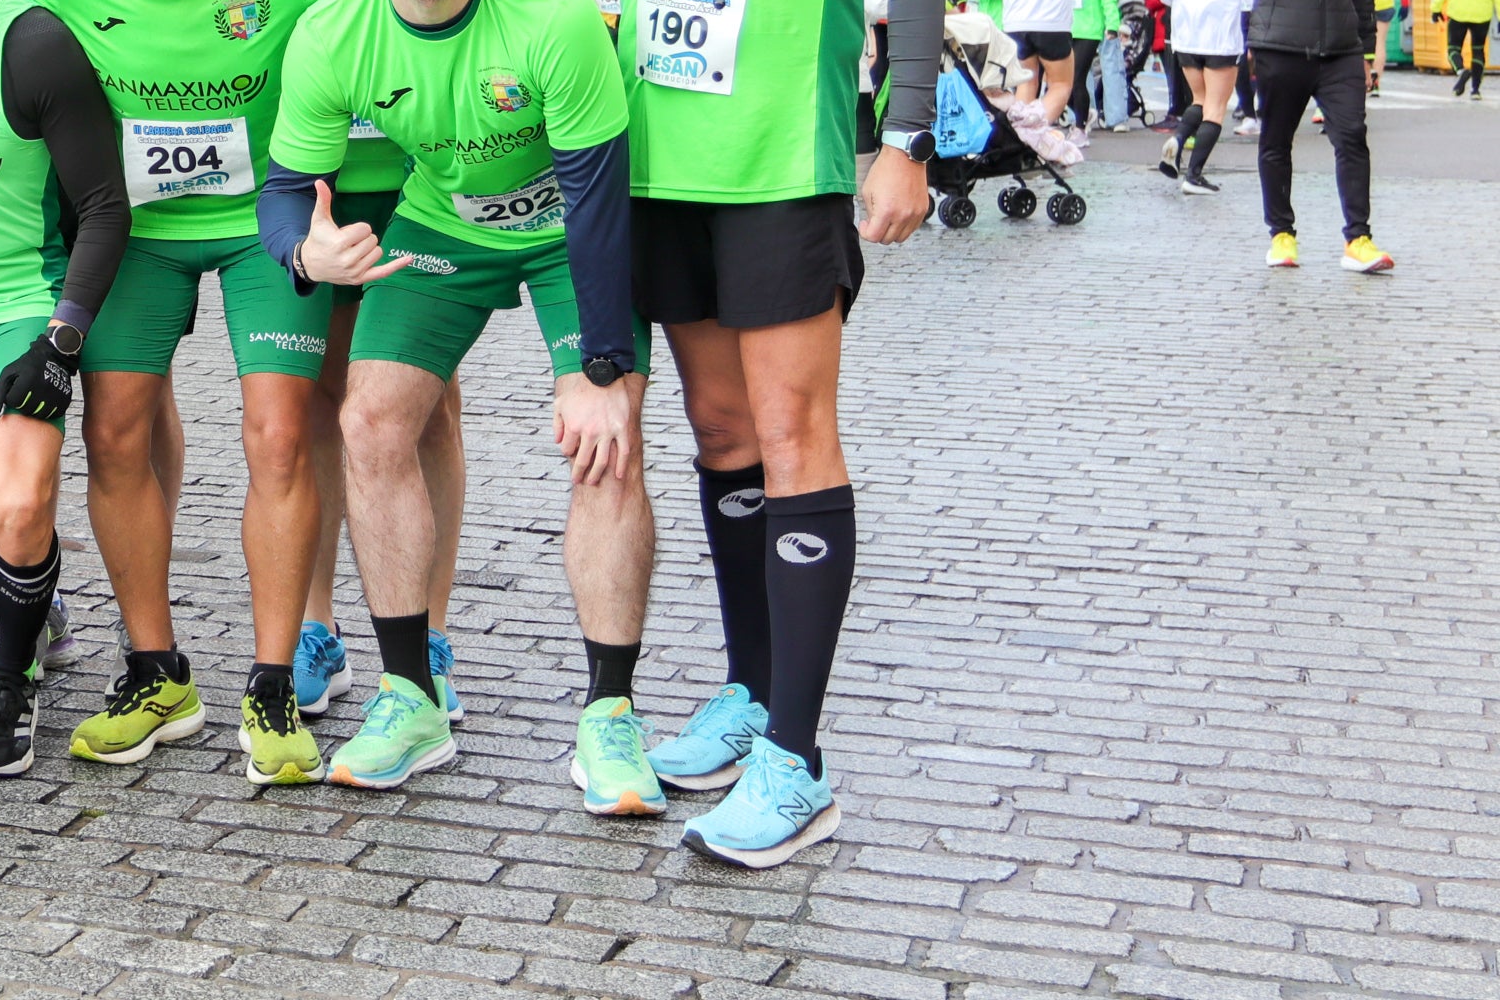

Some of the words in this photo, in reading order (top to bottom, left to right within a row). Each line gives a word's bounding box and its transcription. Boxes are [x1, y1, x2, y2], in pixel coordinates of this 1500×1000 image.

[649, 8, 708, 50] 190
[647, 52, 698, 79] HESAN
[140, 94, 243, 111] TELECOM
[133, 124, 141, 135] III
[143, 125, 184, 136] CARRERA
[185, 123, 234, 136] SOLIDARIA
[146, 145, 223, 175] 204
[455, 138, 532, 165] TELECOM
[157, 175, 223, 193] HESAN
[481, 186, 561, 222] 202
[249, 331, 327, 348] SANMAXIMO
[275, 340, 323, 354] TELECOM
